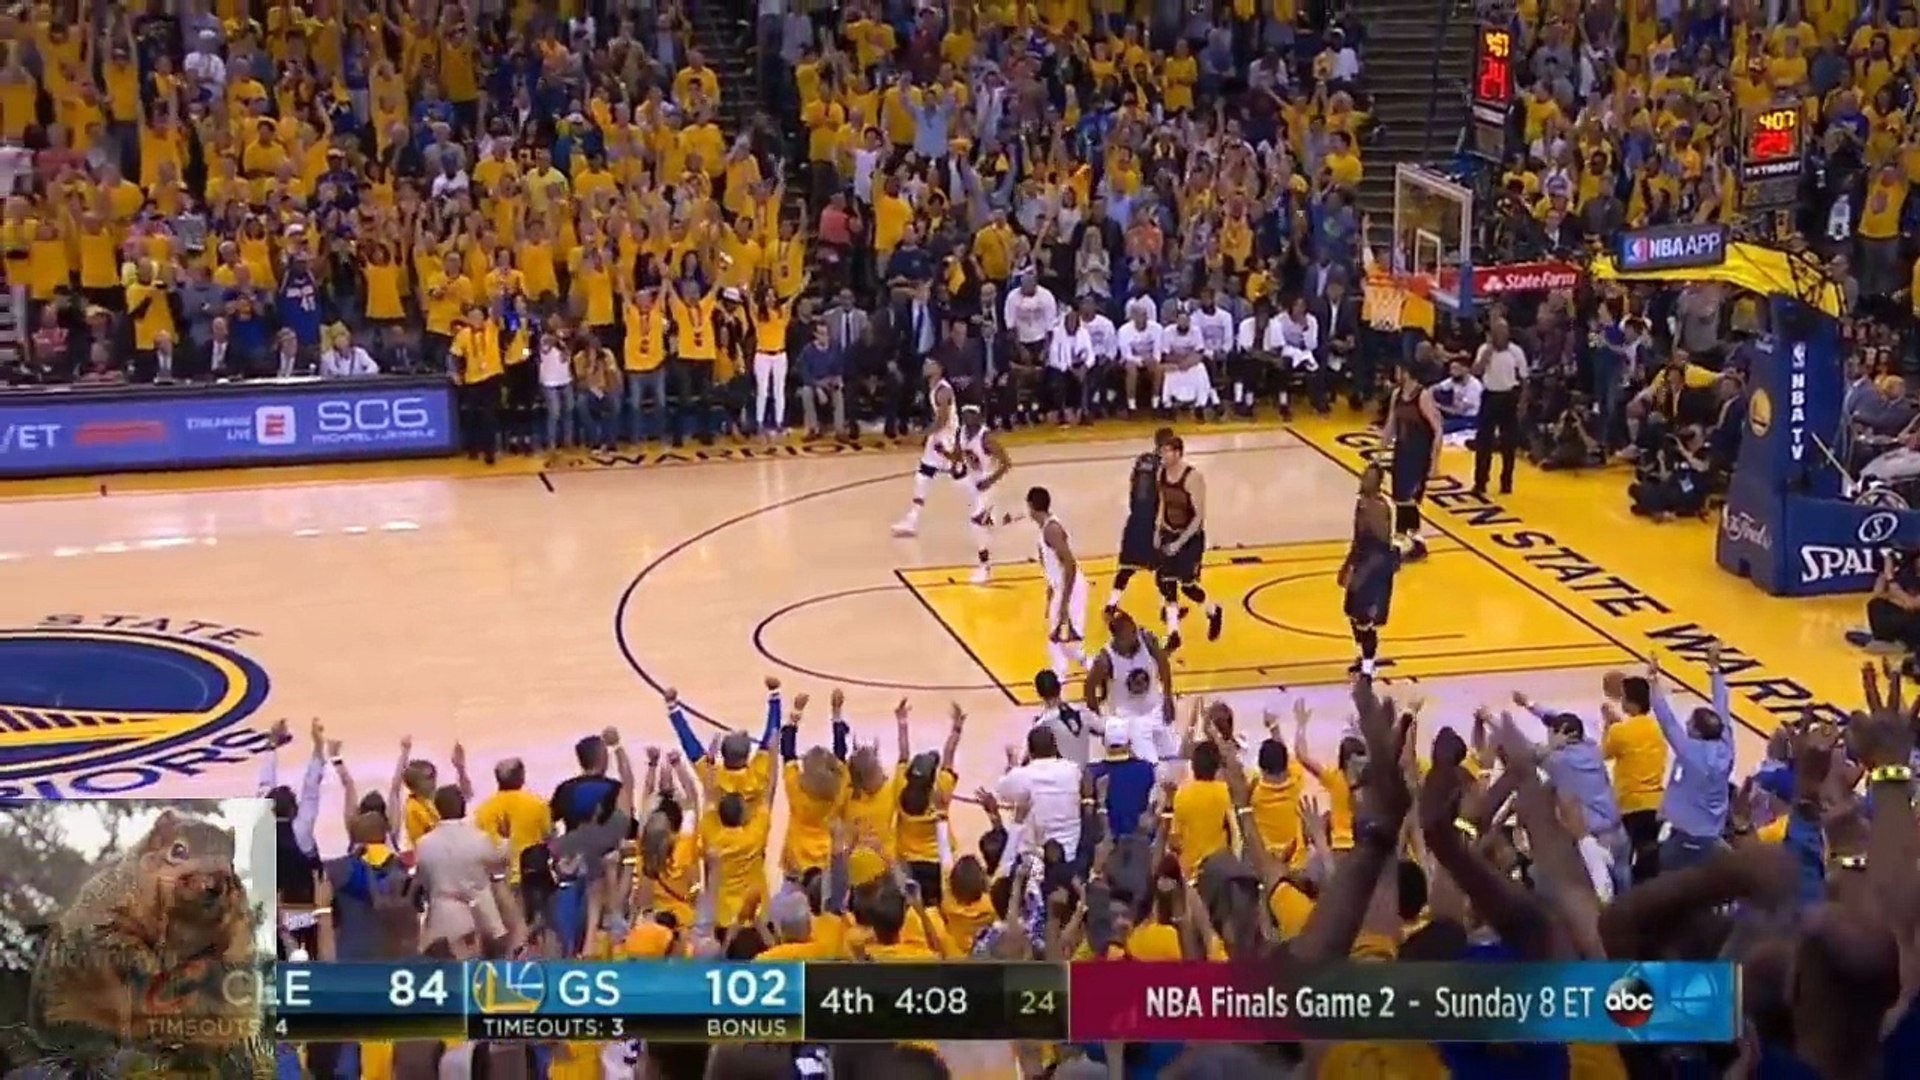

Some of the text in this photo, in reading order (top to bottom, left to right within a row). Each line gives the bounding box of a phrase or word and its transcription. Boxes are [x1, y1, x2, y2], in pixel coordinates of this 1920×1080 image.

[1650, 232, 1721, 258] NBA APP
[317, 398, 429, 432] SC6
[1489, 530, 1672, 618] STATE
[40, 613, 263, 645] STATE
